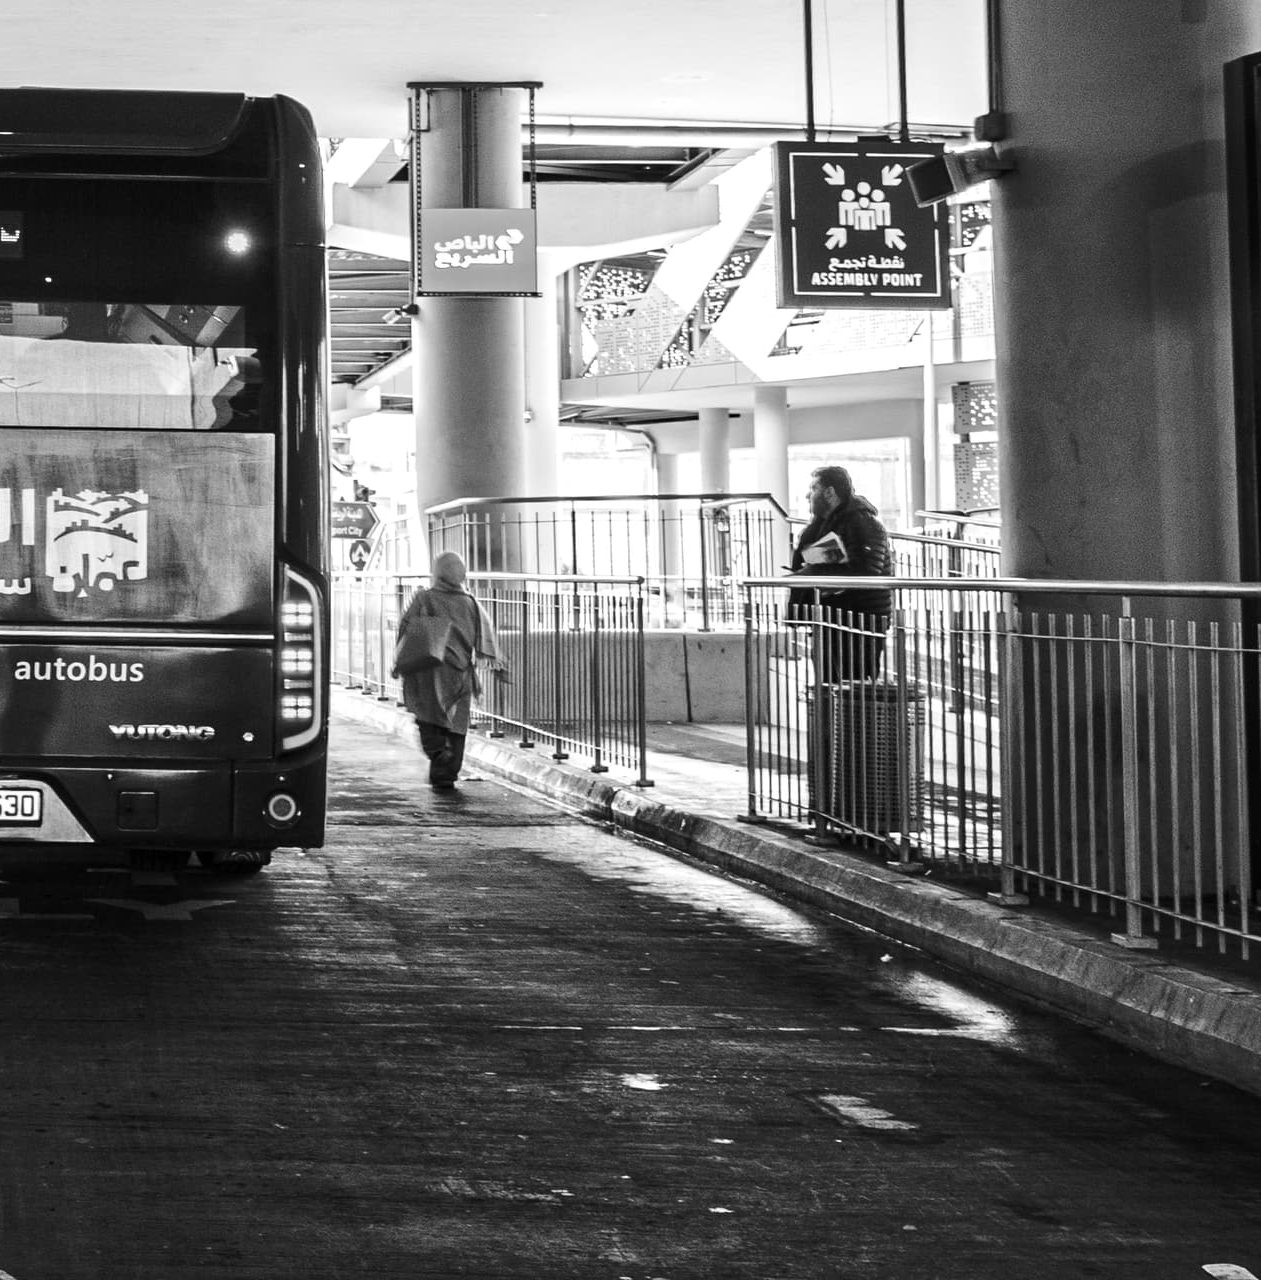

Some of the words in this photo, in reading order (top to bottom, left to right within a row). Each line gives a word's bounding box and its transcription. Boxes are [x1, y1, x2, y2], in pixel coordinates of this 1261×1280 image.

[433, 234, 494, 253] الباص
[434, 250, 514, 269] السريع
[828, 257, 866, 272] تجمع
[867, 255, 905, 269] نقطة
[811, 272, 878, 286] ASSEMBLY
[882, 273, 923, 286] POINT
[348, 527, 363, 538] City
[14, 654, 145, 682] autobus
[107, 724, 216, 741] YUTONG
